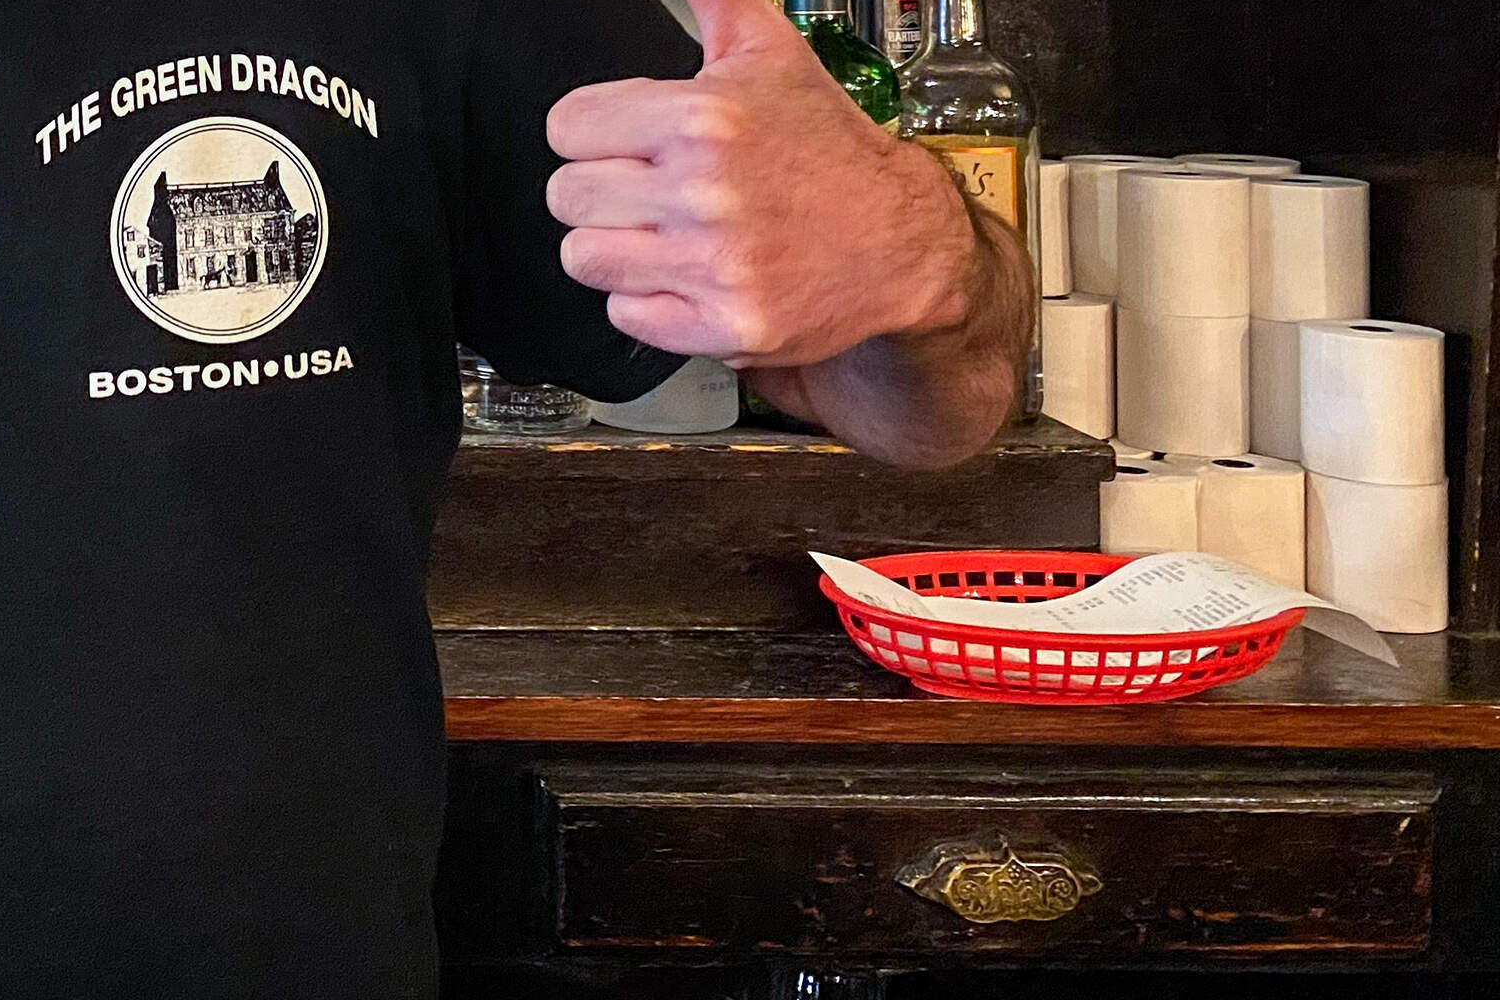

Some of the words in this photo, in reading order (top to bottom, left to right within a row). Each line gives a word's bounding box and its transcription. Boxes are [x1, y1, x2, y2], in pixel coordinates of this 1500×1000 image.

[35, 90, 102, 165] THE
[110, 55, 221, 118] GREEN
[230, 54, 379, 139] DRAGON
